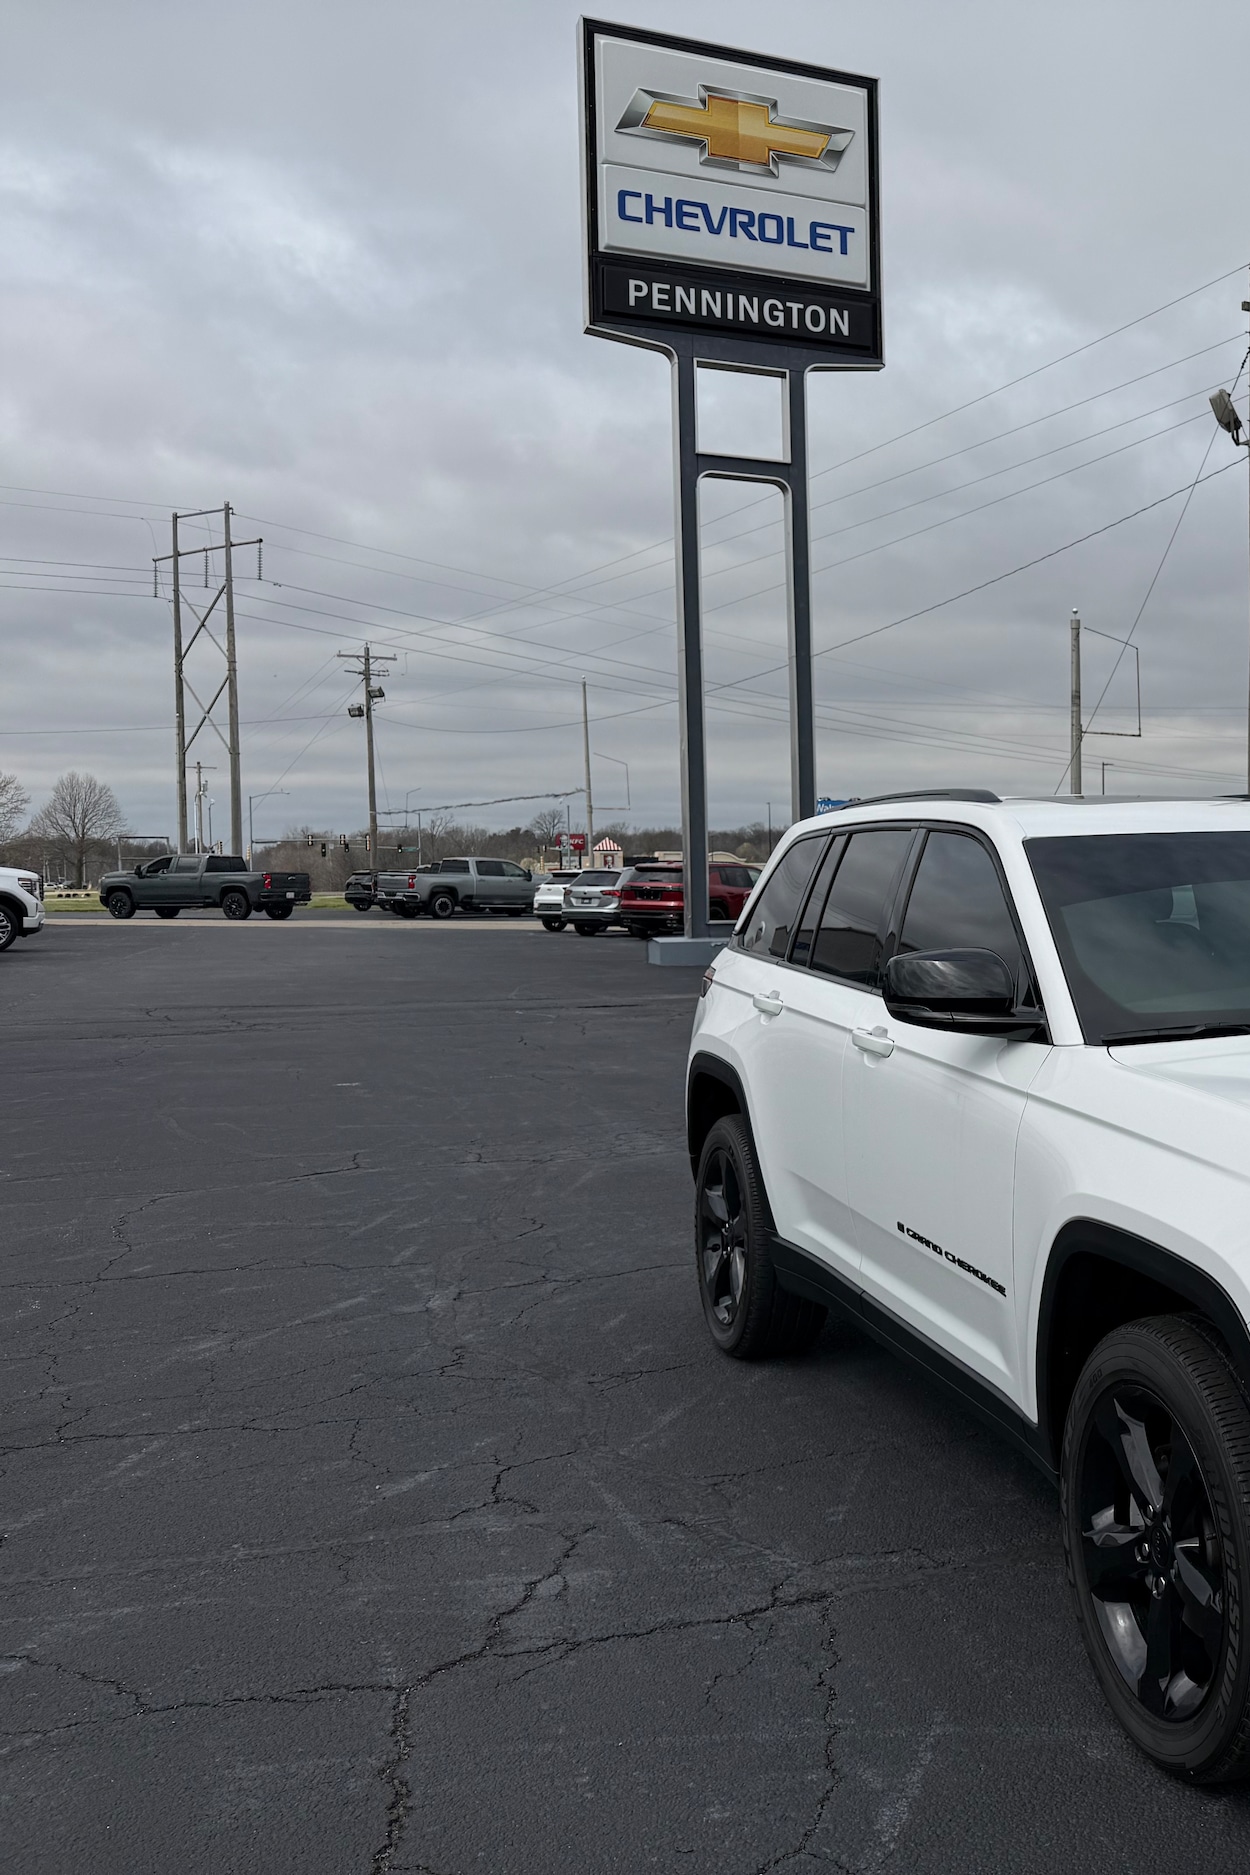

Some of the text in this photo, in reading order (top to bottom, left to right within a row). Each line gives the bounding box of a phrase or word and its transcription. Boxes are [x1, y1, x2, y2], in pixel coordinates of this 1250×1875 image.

[617, 189, 855, 255] CHEVROLET
[628, 279, 850, 336] PENNINGTON
[906, 1227, 1007, 1298] GRAND CHEROKEE
